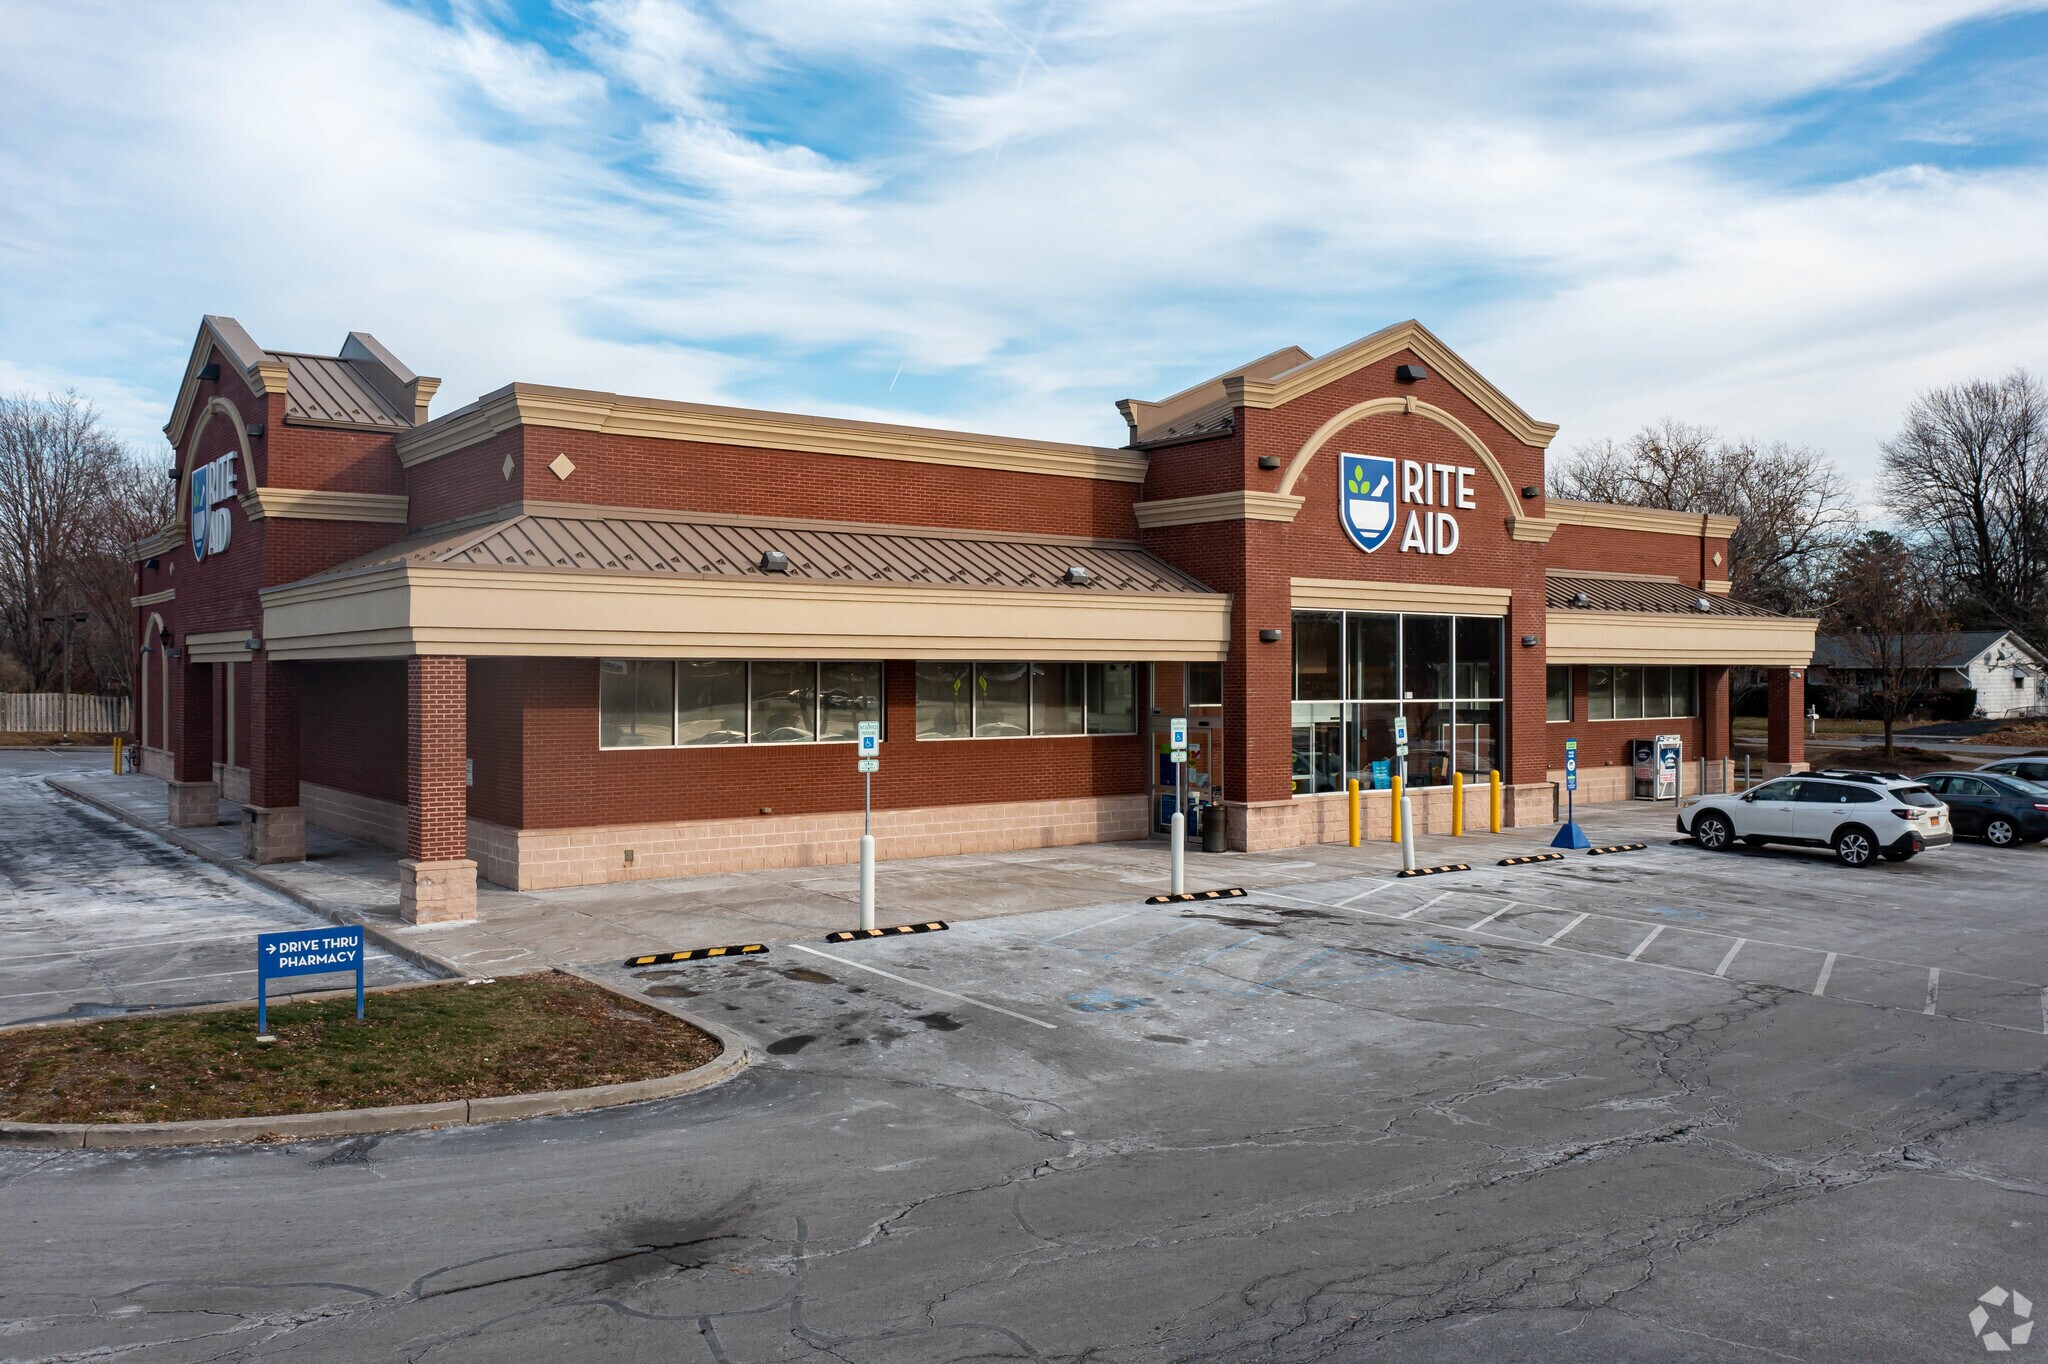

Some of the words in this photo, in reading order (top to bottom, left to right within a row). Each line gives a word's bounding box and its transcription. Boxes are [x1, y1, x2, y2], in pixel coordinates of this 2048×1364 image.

[208, 450, 238, 505] RITE
[1401, 459, 1477, 510] RITE
[207, 506, 232, 556] AID
[1399, 510, 1460, 555] AID
[279, 939, 320, 954] DRIVE
[322, 935, 358, 950] THRU
[279, 950, 357, 968] PHARMACY
